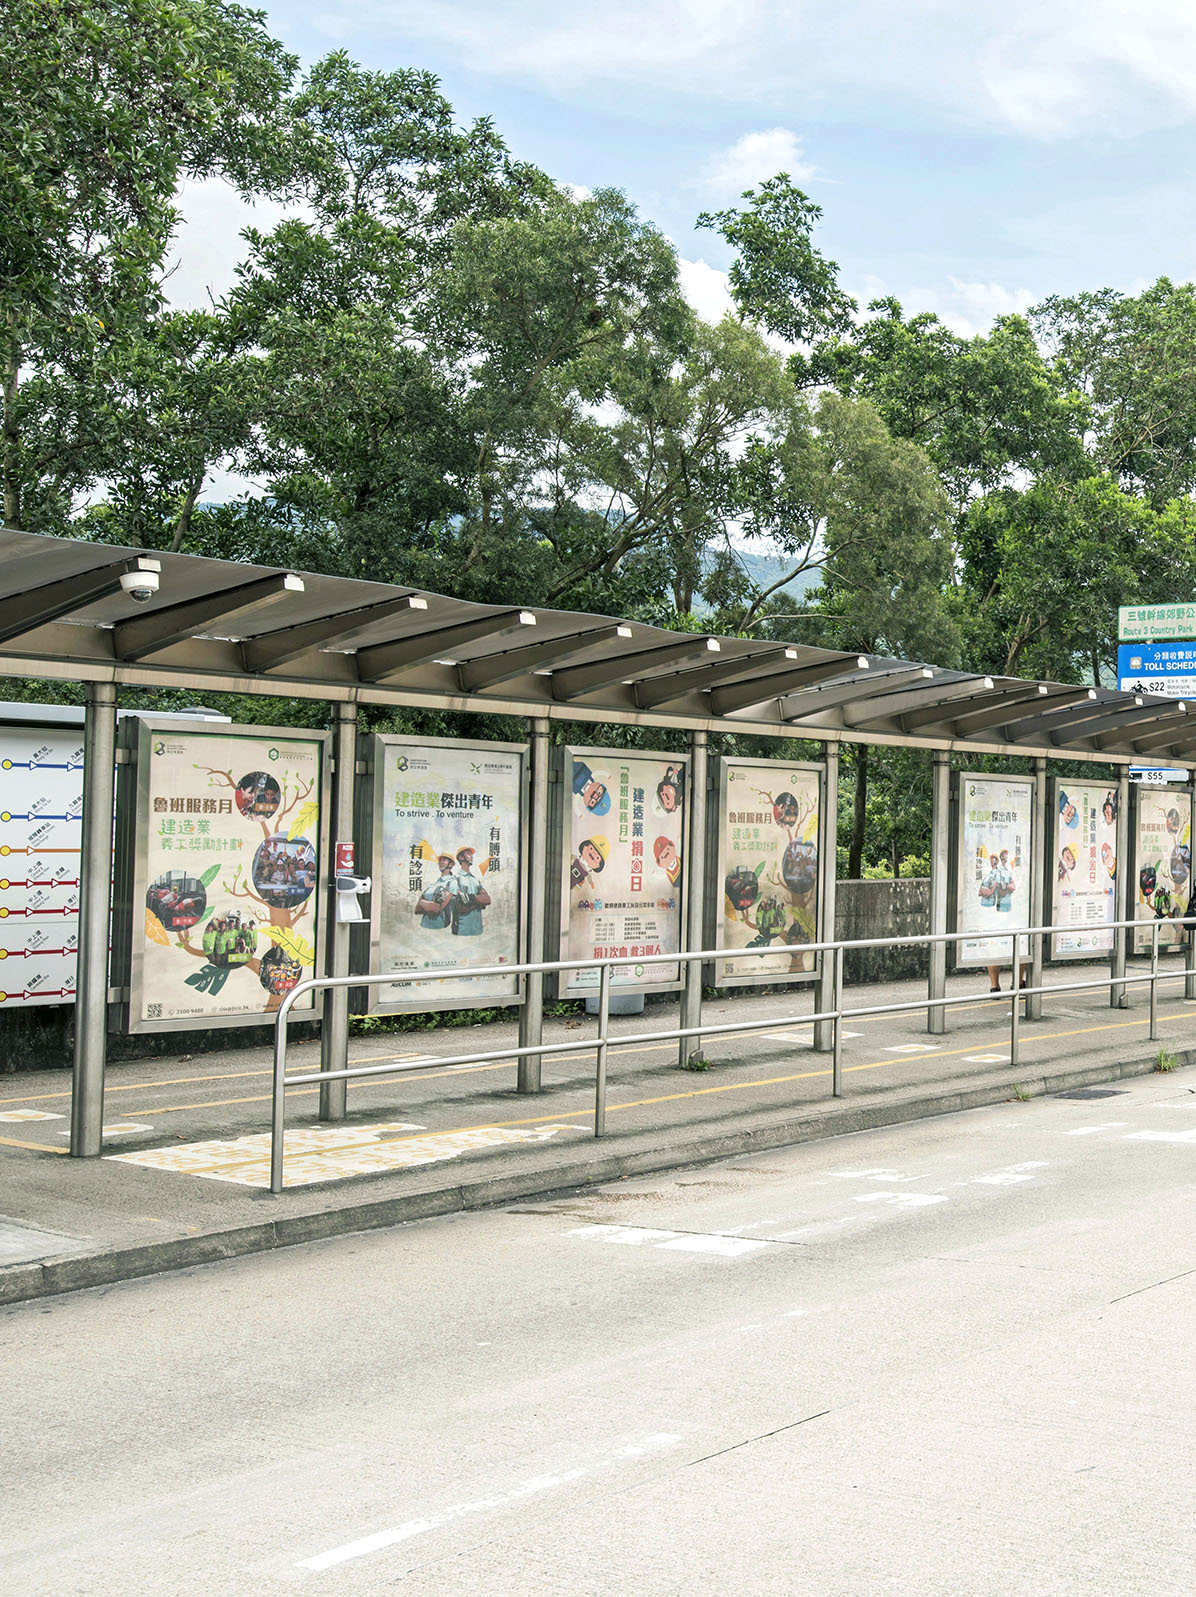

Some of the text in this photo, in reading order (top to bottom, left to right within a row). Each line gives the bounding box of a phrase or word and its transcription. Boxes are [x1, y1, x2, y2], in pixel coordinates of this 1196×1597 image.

[1123, 627, 1142, 636] Route
[1143, 626, 1149, 635] 3
[1150, 625, 1176, 635] Country
[1177, 625, 1194, 633] Park
[1144, 662, 1165, 671] TOLL
[153, 797, 233, 814] 魯班服務月
[395, 791, 494, 810] 建造業傑出青年
[395, 809, 405, 818] To
[407, 809, 430, 818] strive
[436, 810, 445, 818] To
[446, 811, 475, 819] venture
[728, 811, 773, 824] 魯班服務月
[161, 818, 211, 835] 建造業
[409, 844, 424, 892] 有諗頭
